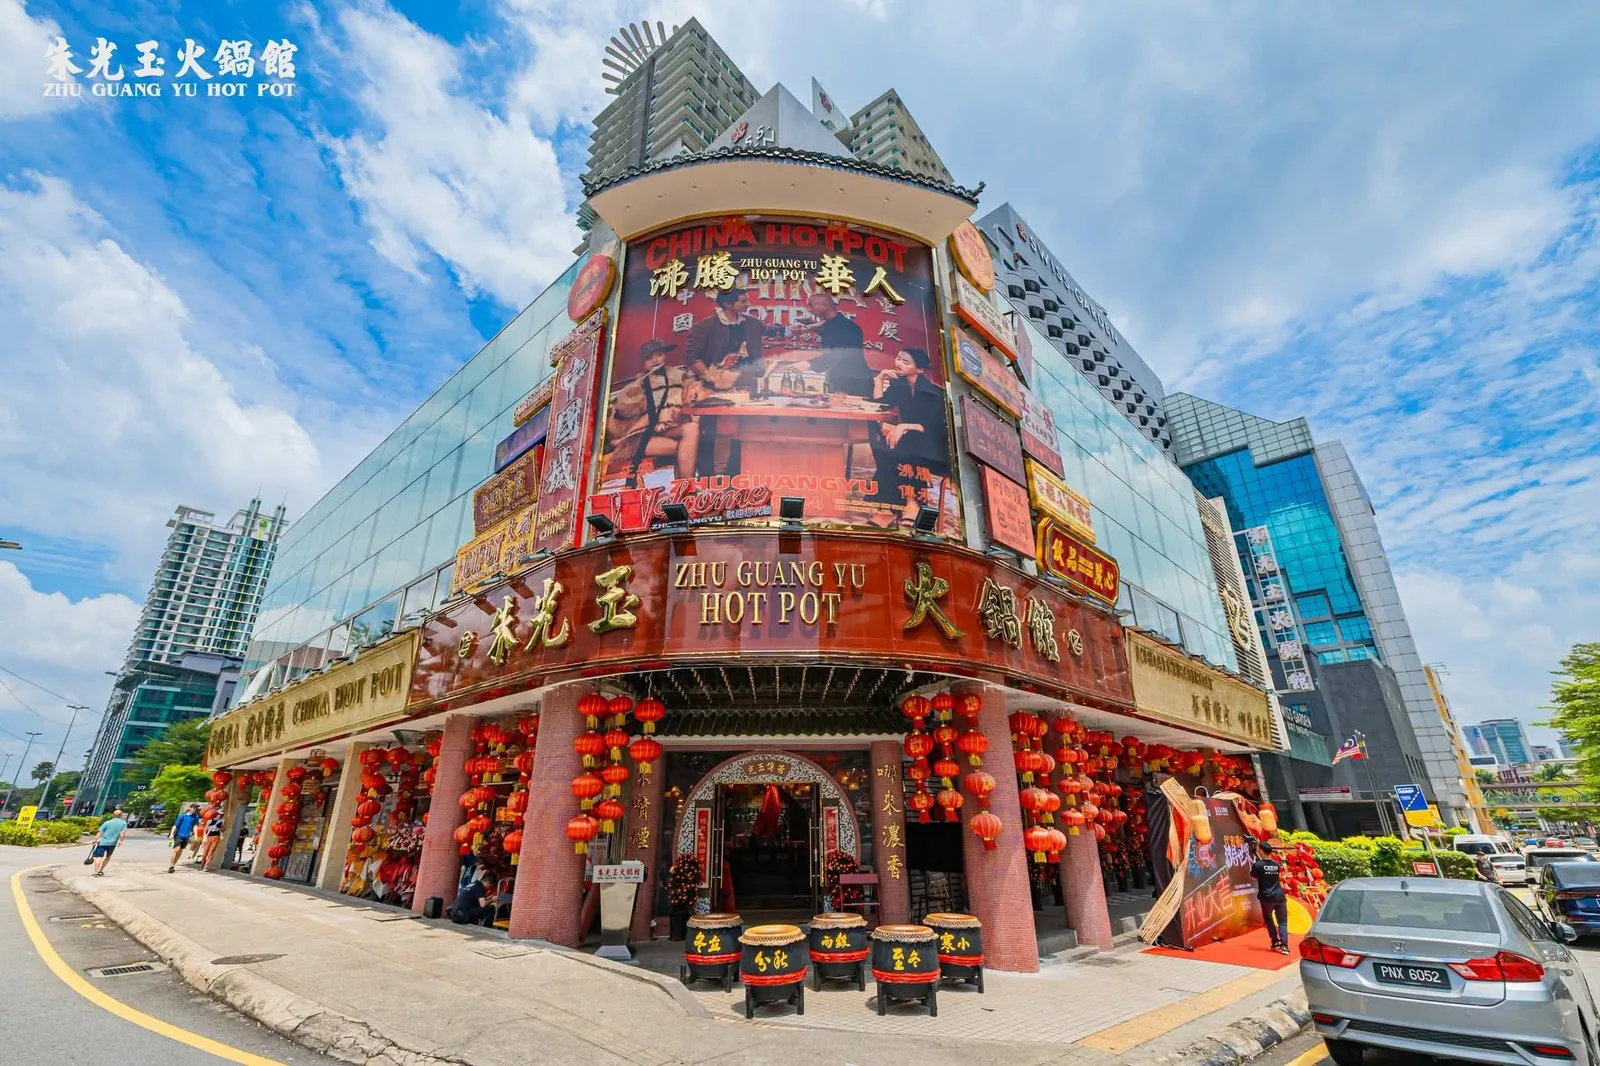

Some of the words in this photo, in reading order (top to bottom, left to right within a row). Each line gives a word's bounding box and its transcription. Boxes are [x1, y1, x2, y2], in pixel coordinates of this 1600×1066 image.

[645, 223, 758, 272] CHINA
[766, 224, 909, 273] HOTPOT
[740, 258, 763, 269] ZHU
[765, 259, 801, 269] GUANG
[803, 260, 818, 271] YU
[650, 251, 740, 298] 沸騰
[814, 253, 906, 303] 華人
[751, 269, 779, 281] HOT
[782, 270, 807, 282] POT
[670, 473, 879, 496] ZHUGUANGYU
[587, 481, 773, 535] Welcome
[674, 561, 726, 588] ZHU
[736, 560, 824, 587] GUANG
[834, 562, 866, 589] YU
[486, 564, 641, 665] 朱光玉
[903, 562, 1061, 662] 火鍋館
[700, 591, 767, 625] HOT
[779, 592, 842, 626] POT
[292, 690, 331, 726] CHINA
[370, 661, 405, 699] POT
[1380, 965, 1405, 980] PNX
[1408, 969, 1442, 983] 6052
